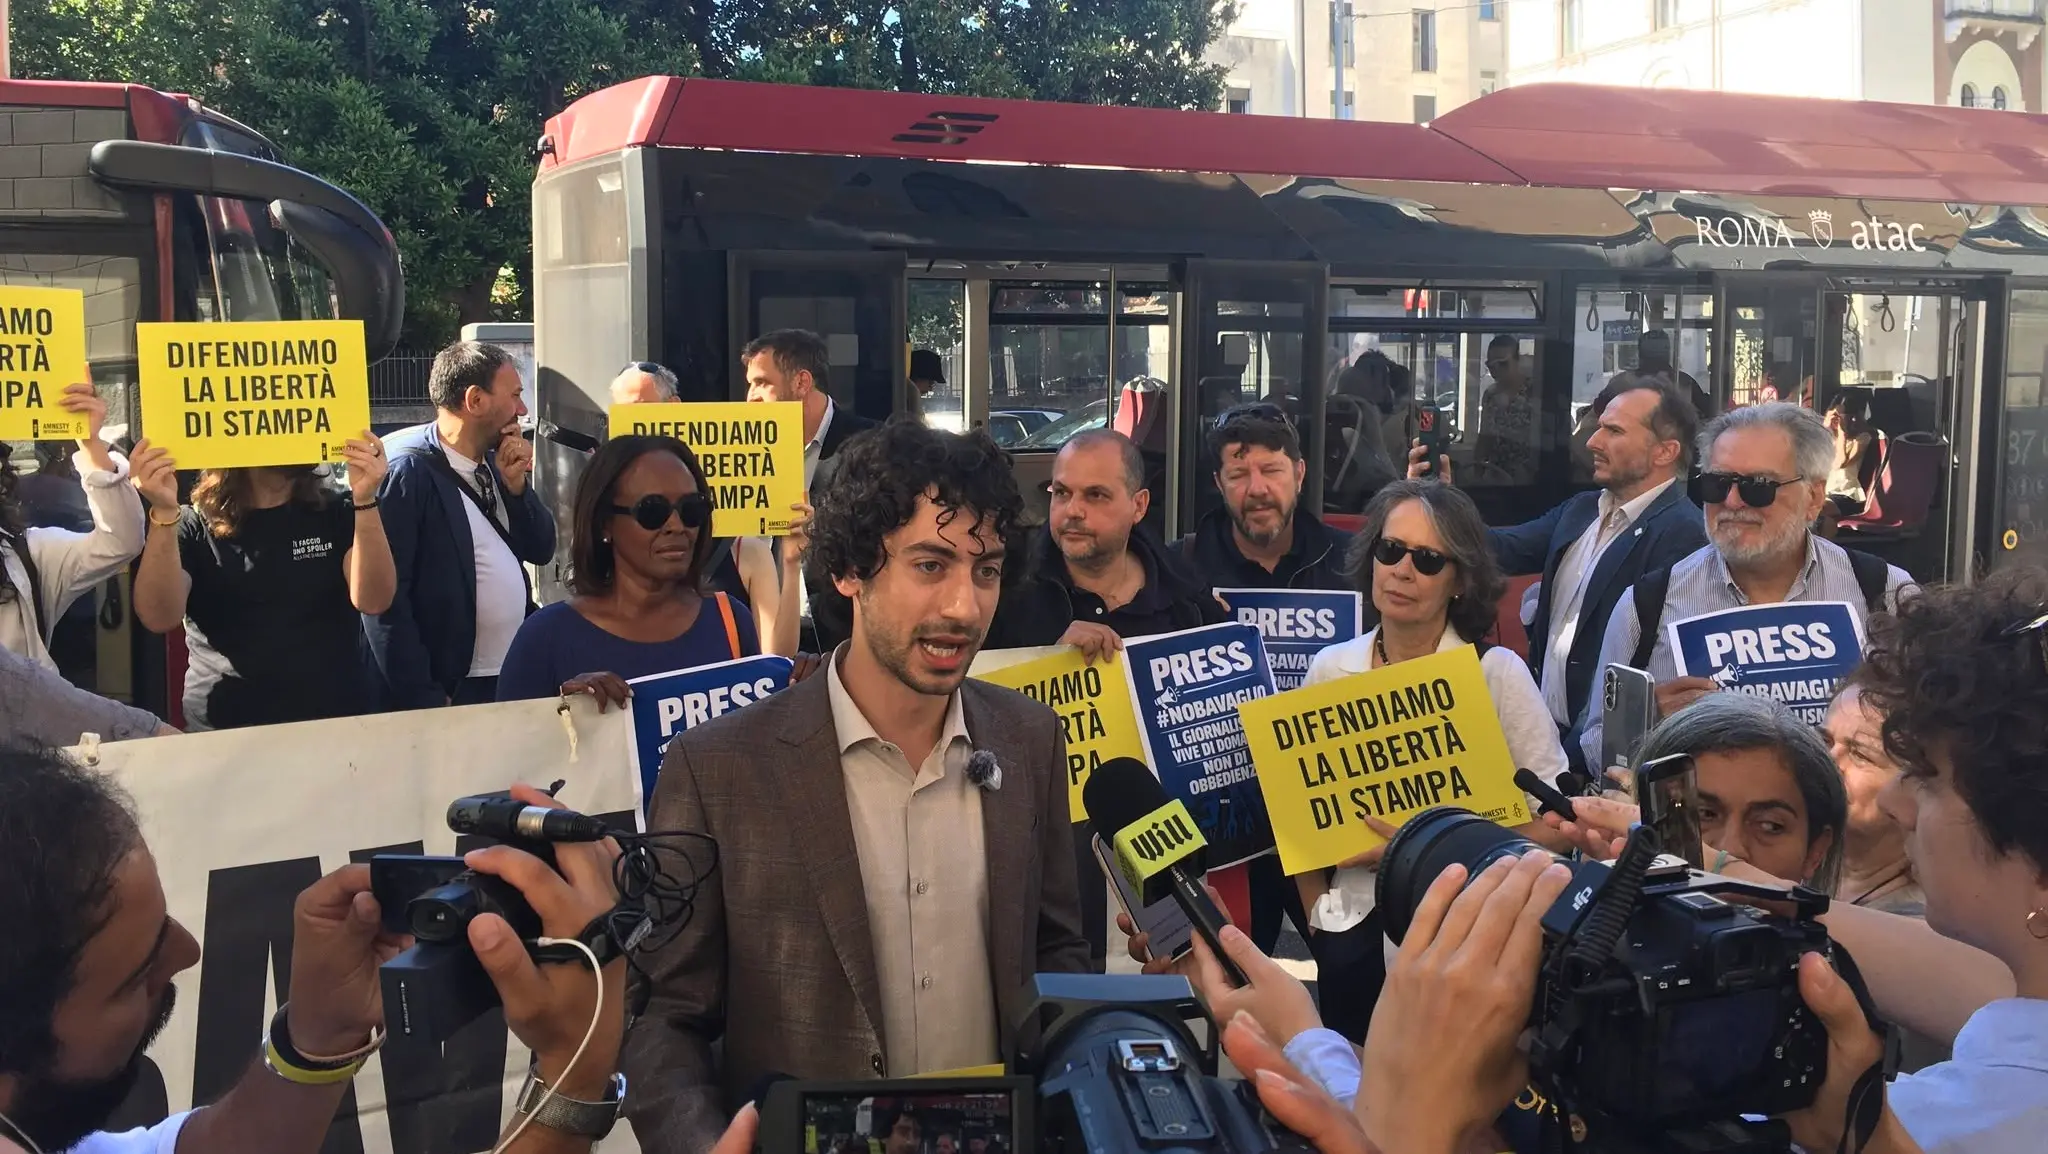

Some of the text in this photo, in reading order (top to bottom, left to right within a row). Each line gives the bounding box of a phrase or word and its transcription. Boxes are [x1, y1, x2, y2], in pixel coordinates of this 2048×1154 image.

[1695, 216, 1927, 252] ROMA atac
[167, 338, 337, 368] DIFENDIAMO
[183, 367, 337, 403] LA LIBERTÀ
[185, 407, 331, 438] DI STAMPA
[307, 542, 333, 553] SPOILER
[1237, 607, 1336, 639] PRESS
[1705, 622, 1837, 668] PRESS
[1149, 641, 1253, 692] PRESS
[1271, 677, 1456, 752] DIFENDIAMO
[1168, 732, 1181, 749] IL
[1172, 744, 1201, 764] VIVE
[1202, 740, 1215, 757] DI
[1298, 715, 1467, 789] LA LIBERTÀ
[1203, 750, 1249, 776] NON DI
[1310, 765, 1473, 830] DI STAMPA
